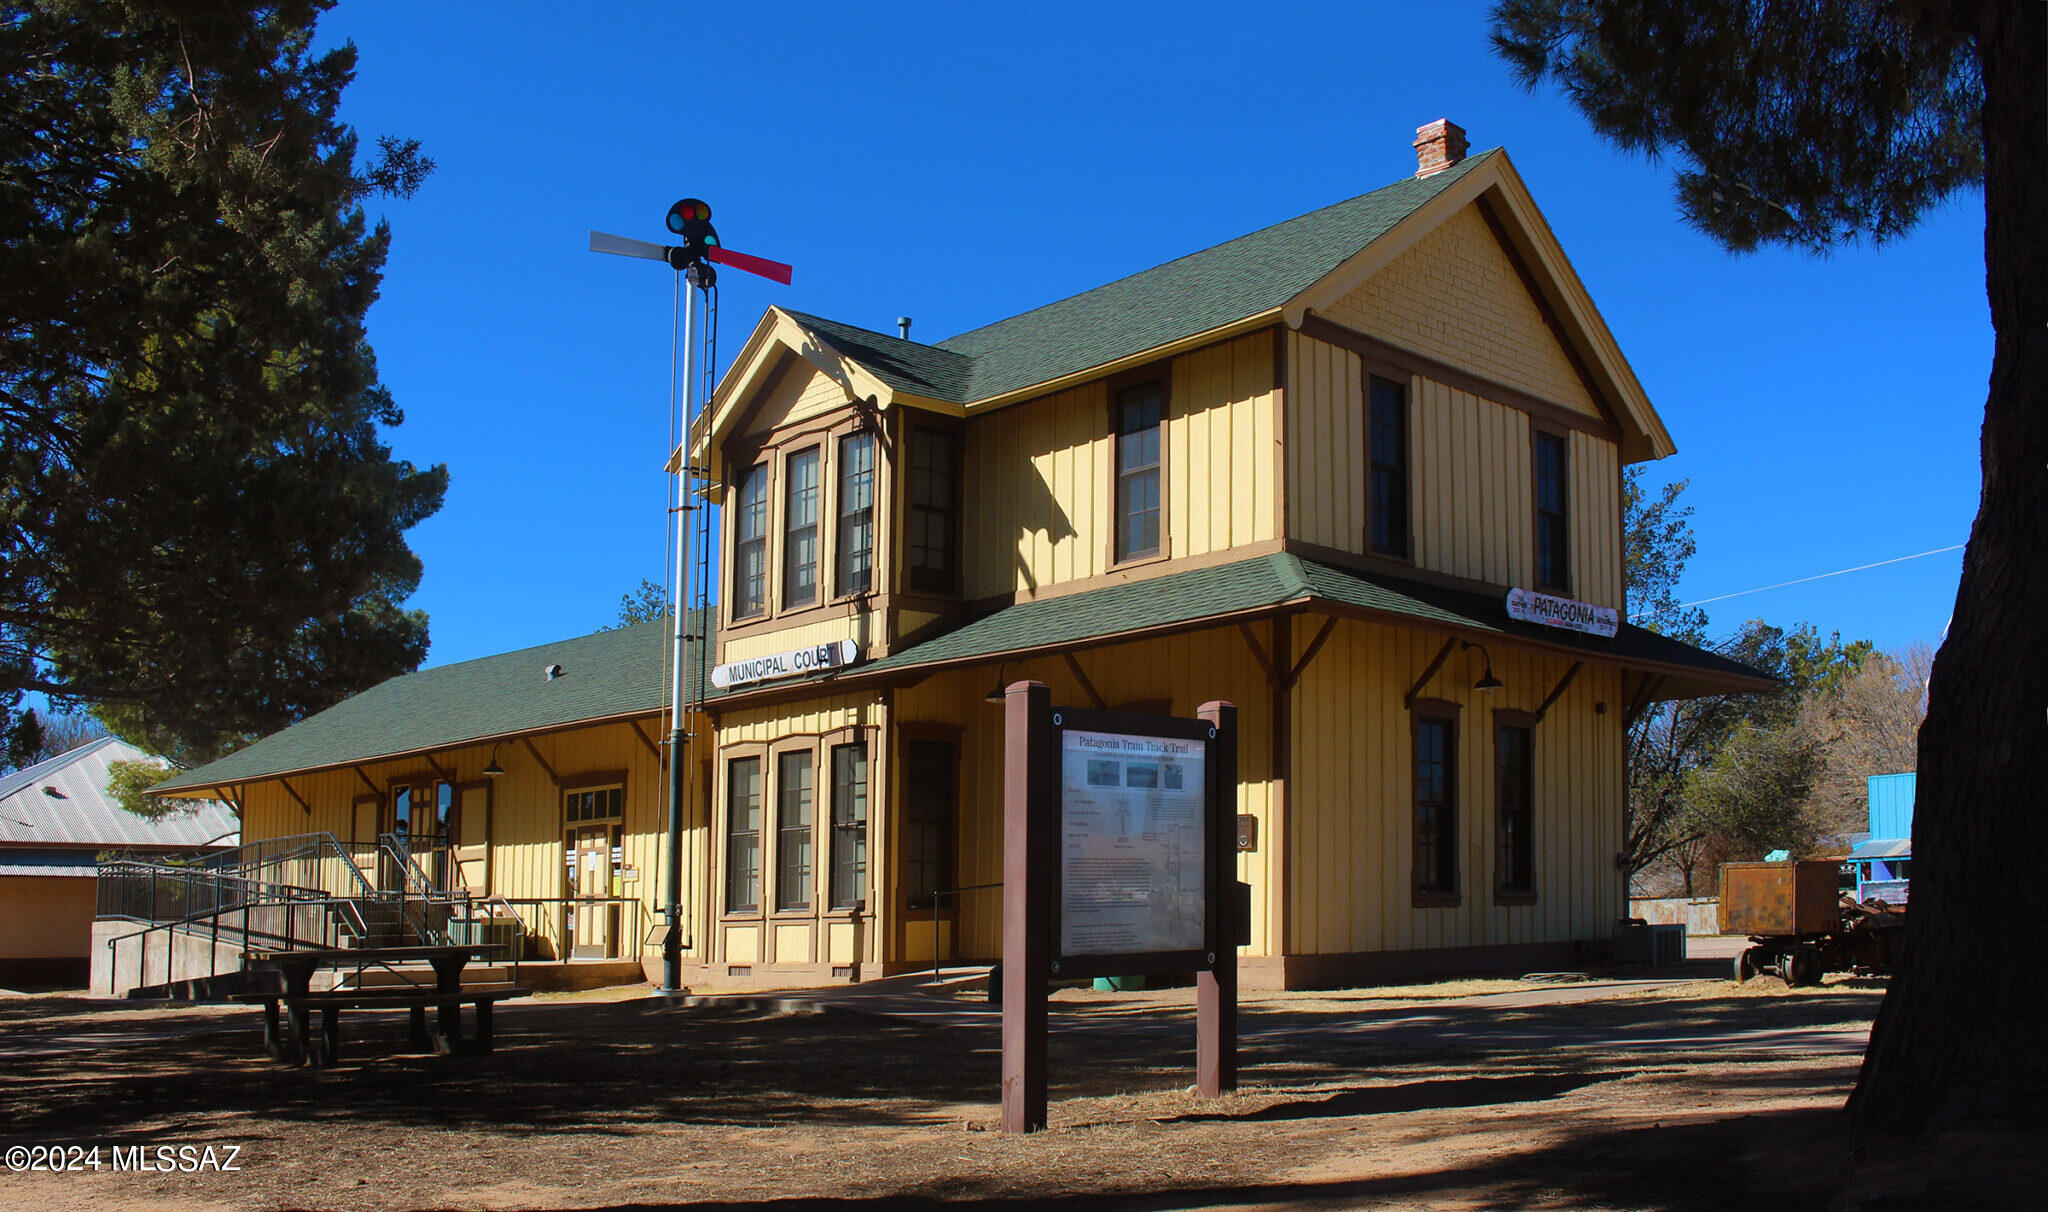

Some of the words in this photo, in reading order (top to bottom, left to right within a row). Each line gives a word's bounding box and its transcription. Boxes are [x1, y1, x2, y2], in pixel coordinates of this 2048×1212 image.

[1534, 597, 1595, 625] PATAGONIA
[729, 657, 787, 682] MUNICIPAL
[794, 646, 835, 669] COURT
[1079, 736, 1120, 750] Patagonia
[1122, 739, 1144, 751] Train
[1146, 741, 1169, 753] Track
[1170, 743, 1189, 754] Trail
